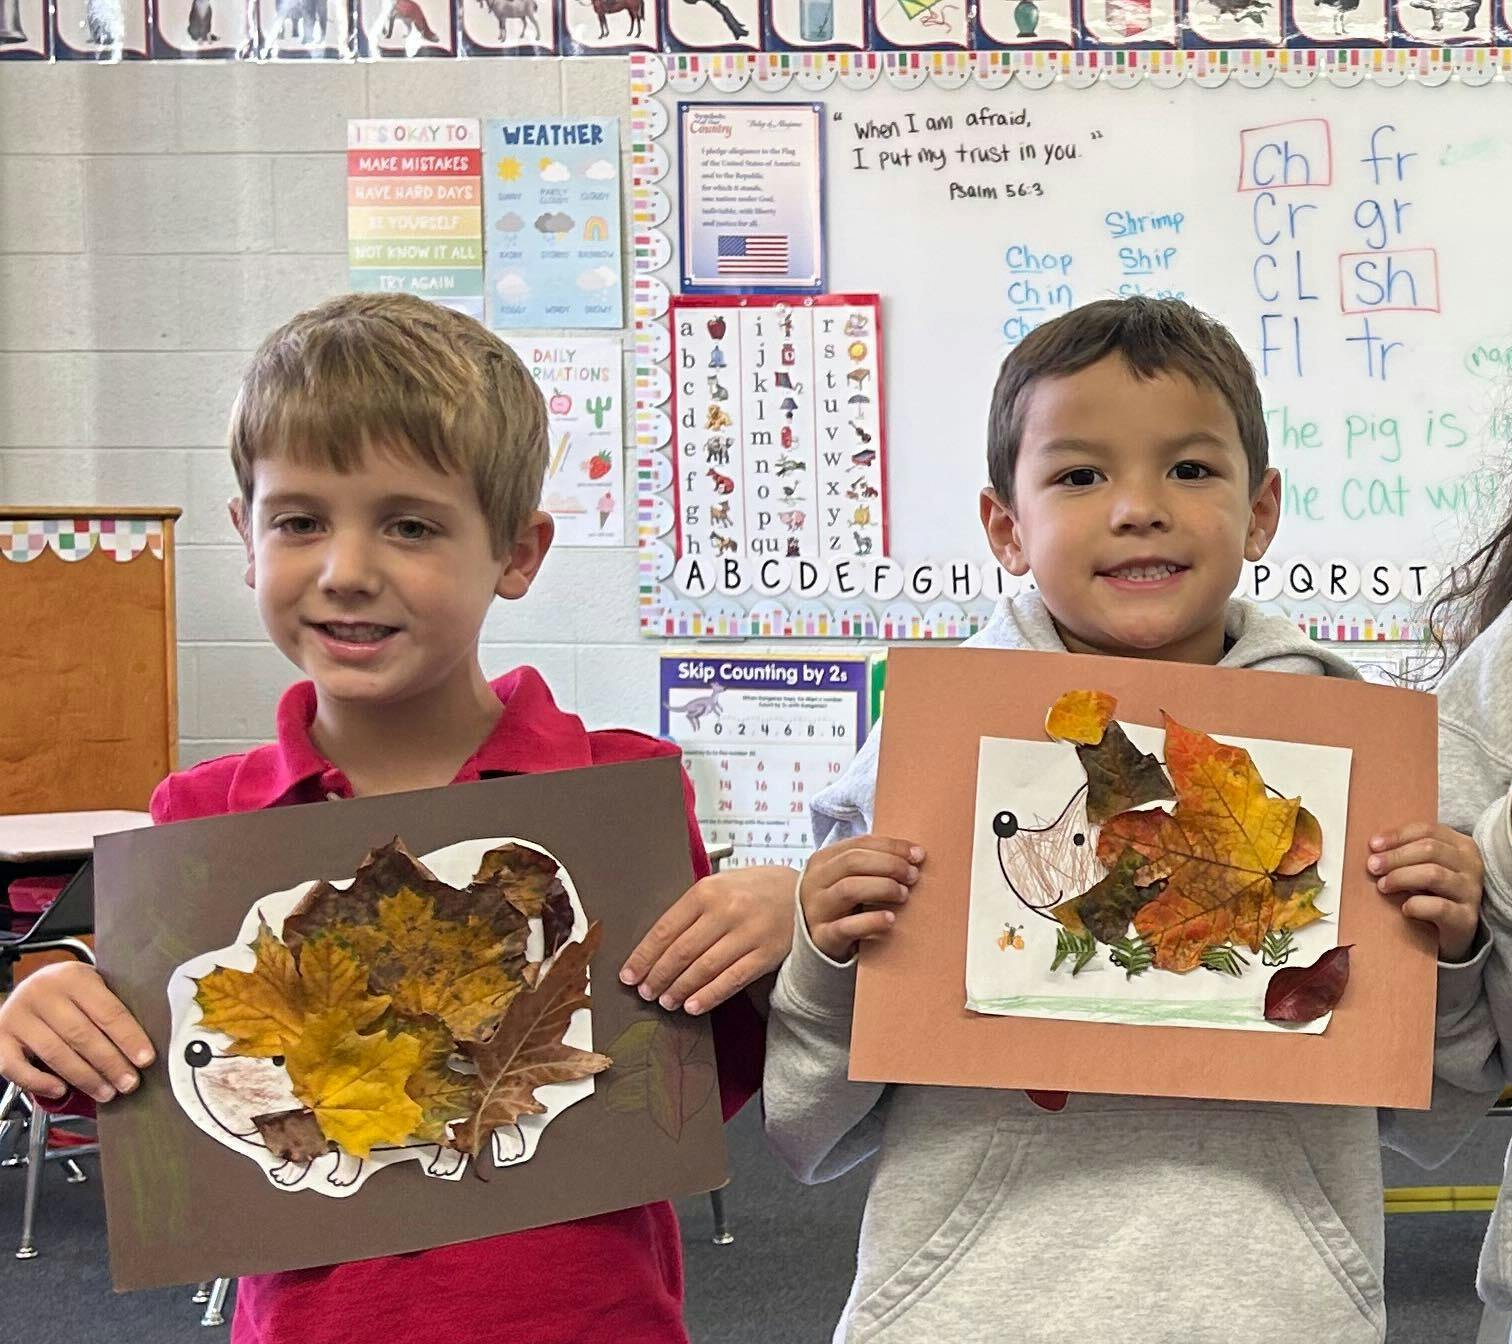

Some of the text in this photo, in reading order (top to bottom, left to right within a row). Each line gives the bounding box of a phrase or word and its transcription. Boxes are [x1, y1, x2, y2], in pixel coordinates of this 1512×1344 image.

[905, 113, 920, 133] I
[926, 115, 953, 131] am
[965, 107, 1031, 128] afraid,
[394, 126, 440, 141] OKAY
[446, 125, 467, 142] TO
[502, 124, 603, 146] WEATHER
[690, 121, 732, 139] Country
[359, 157, 469, 171] MAKE MISTAKES
[854, 149, 869, 170] I
[879, 147, 911, 170] put
[918, 149, 946, 170] my
[955, 143, 1010, 163] trust
[1019, 143, 1036, 160] in
[1361, 125, 1417, 185] fr
[356, 186, 473, 199] HAVE HARD DAYS
[949, 182, 998, 200] Psalm
[1105, 211, 1185, 237] Shrimp
[1354, 198, 1413, 249] gr
[356, 245, 475, 259] NOT KNOW IT ALL
[1006, 246, 1073, 275] Chop
[380, 276, 455, 290] TRY AGAIN
[1008, 283, 1073, 309] Chin
[680, 321, 693, 337] a
[533, 349, 576, 363] DAILY
[1346, 318, 1404, 380] tr
[682, 350, 695, 368] b
[533, 367, 609, 382] RMATIONS
[683, 381, 694, 395] c
[682, 409, 695, 428] d
[1346, 413, 1400, 462] pig
[1426, 410, 1467, 447] is
[684, 442, 696, 457] e
[686, 472, 696, 491] f
[687, 504, 699, 525] g
[688, 534, 700, 553] h
[686, 560, 704, 590] A
[724, 559, 741, 589] B
[761, 559, 781, 588] C
[800, 560, 818, 590] D
[836, 561, 855, 592] E
[874, 565, 890, 592] F
[912, 566, 932, 594] G
[953, 564, 970, 595] H
[1254, 564, 1428, 596] P Q R S T
[679, 662, 847, 685] Skip Counting by 2s
[832, 725, 845, 737] 10
